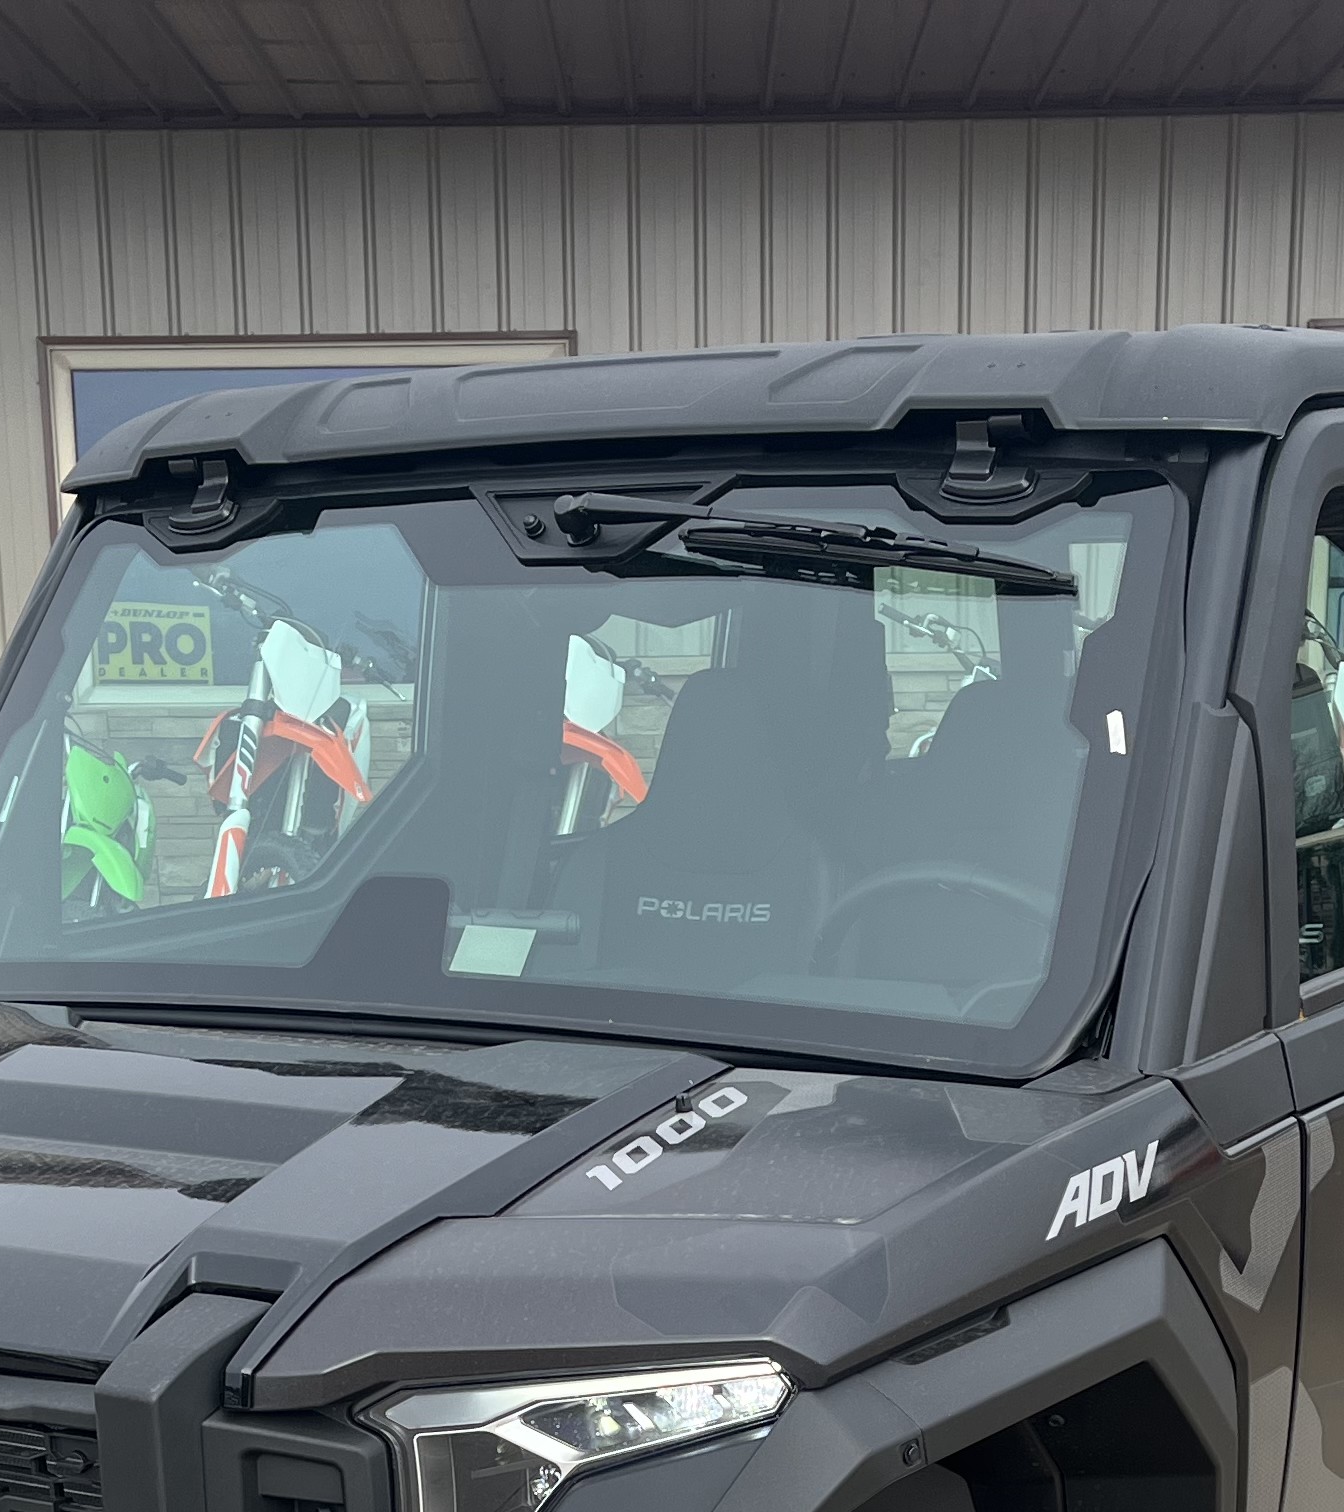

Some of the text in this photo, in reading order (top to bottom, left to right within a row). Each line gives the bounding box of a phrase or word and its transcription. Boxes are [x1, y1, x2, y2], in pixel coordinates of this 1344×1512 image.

[97, 620, 207, 667] PRO
[98, 667, 208, 678] DEALER
[635, 896, 772, 924] POLARIS
[585, 1084, 749, 1192] 1000
[1043, 1139, 1161, 1242] ADV
